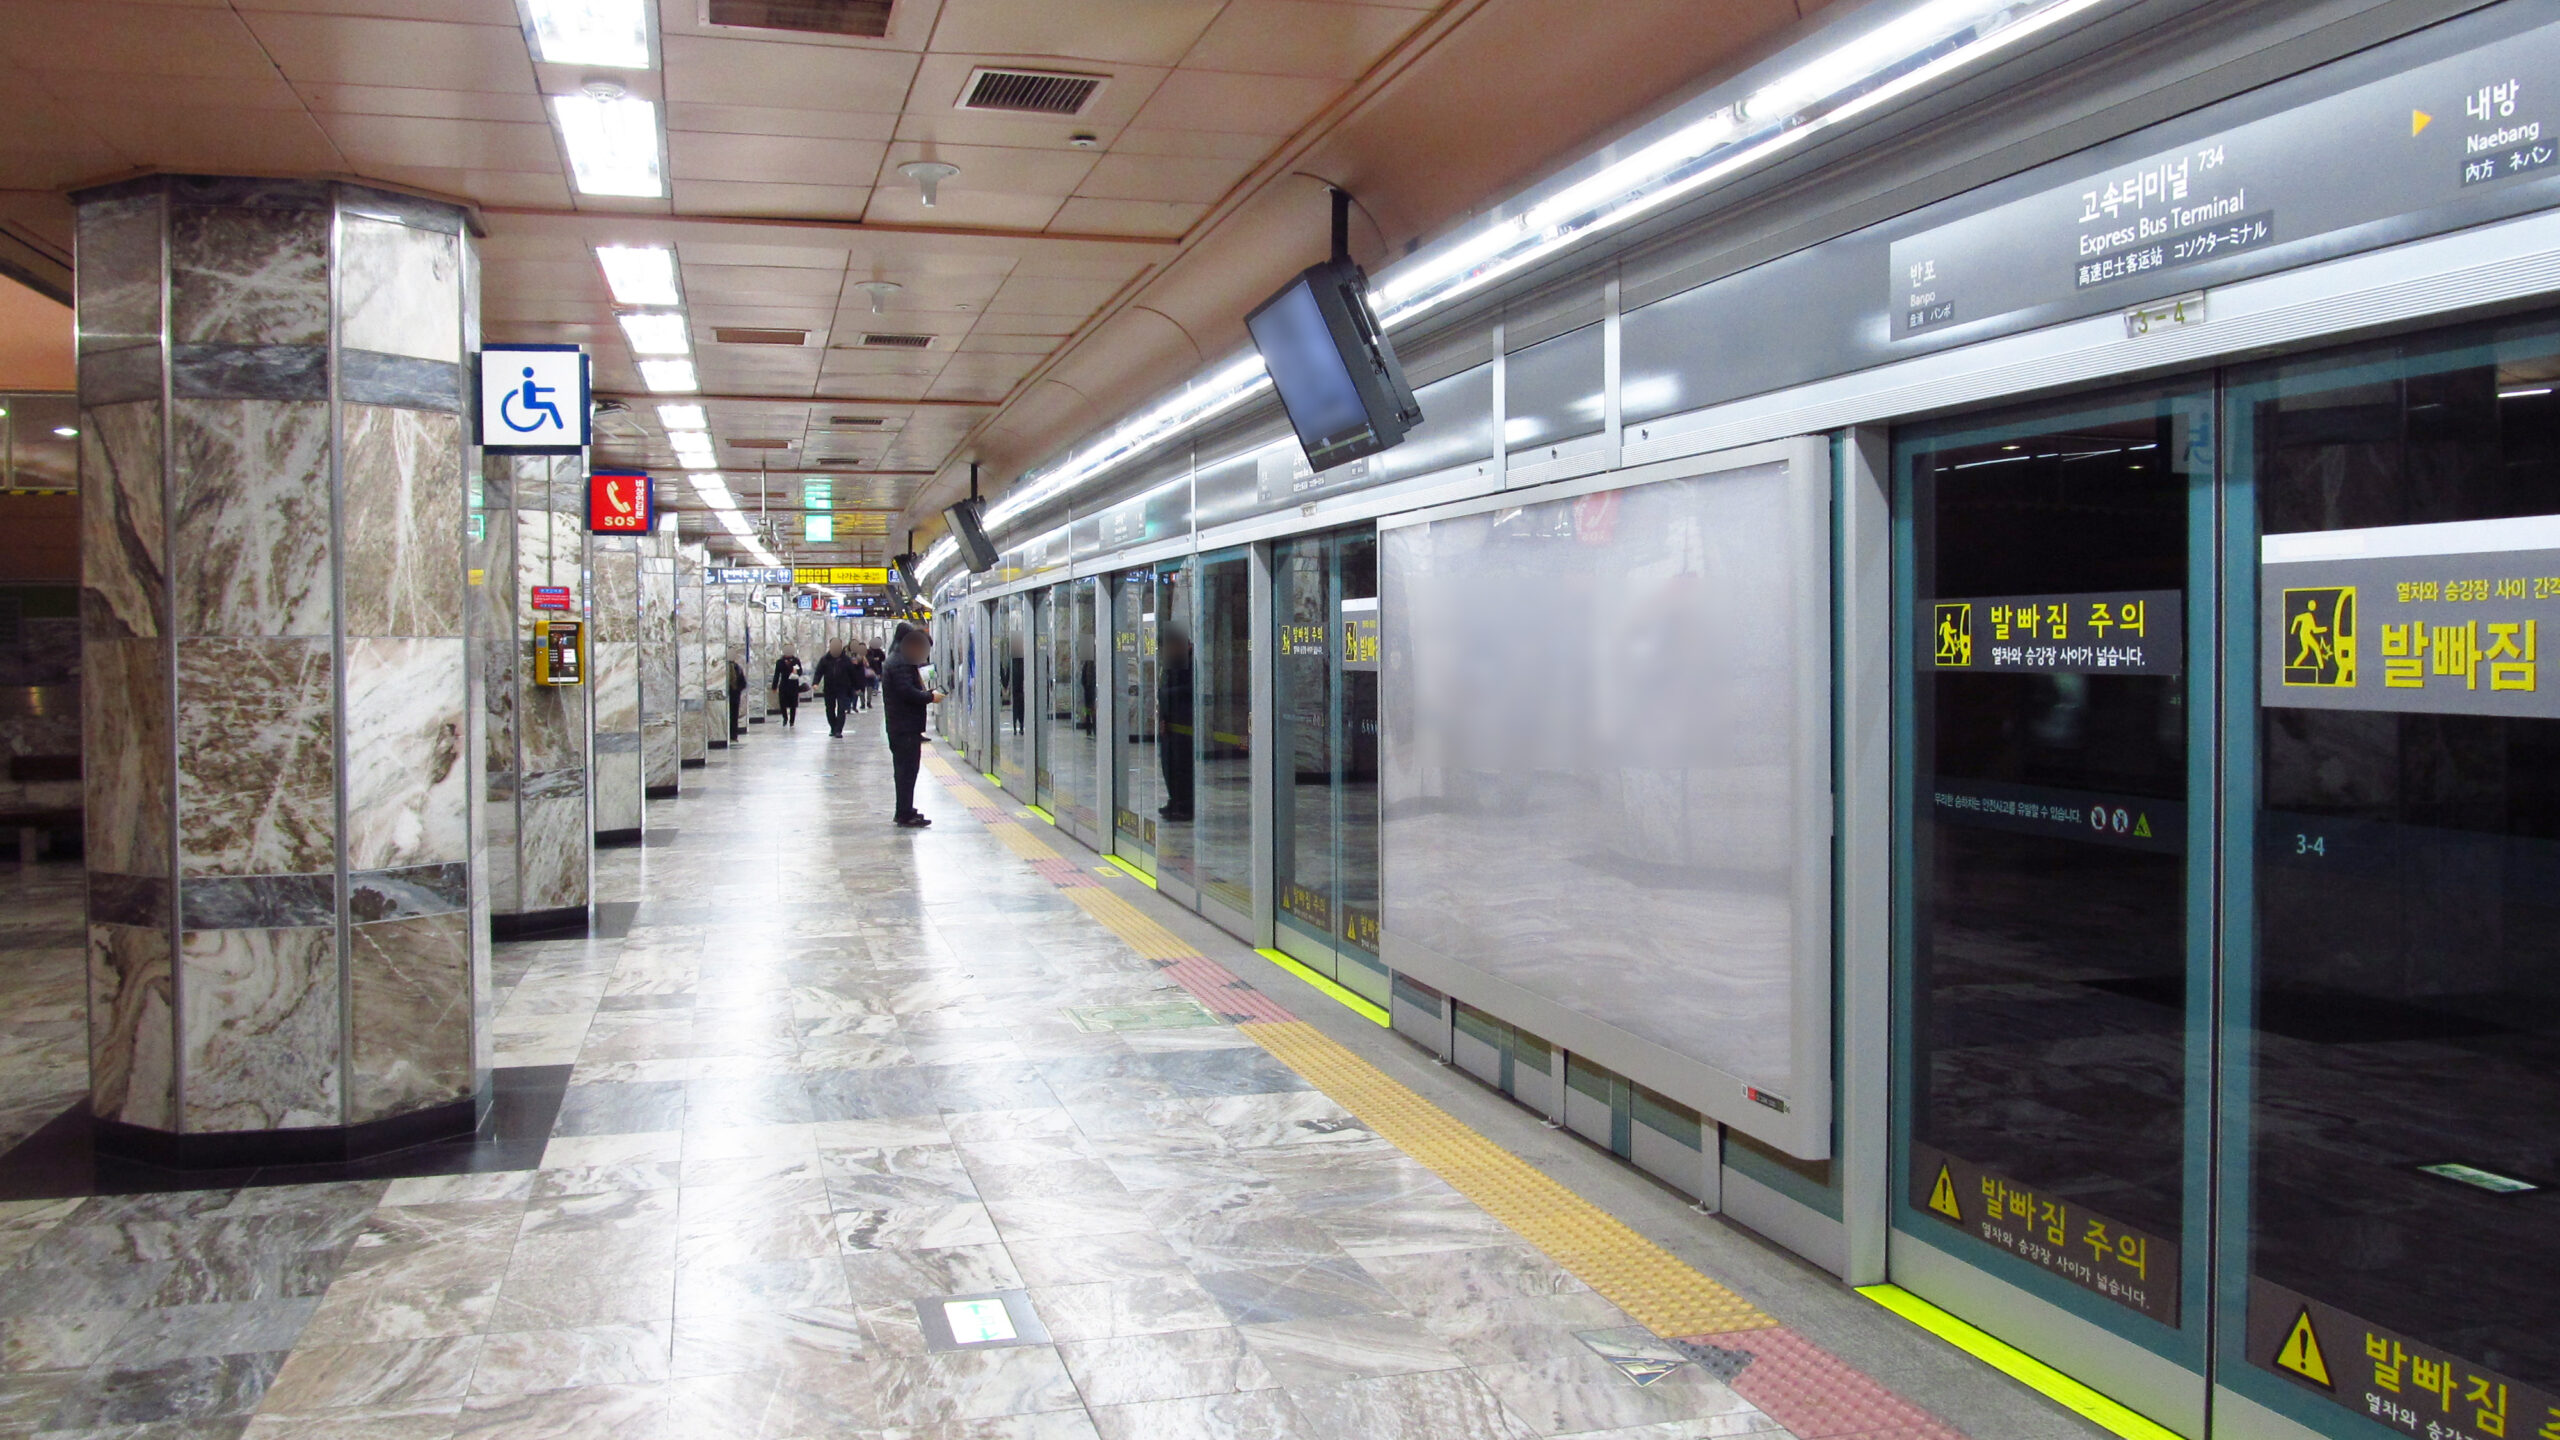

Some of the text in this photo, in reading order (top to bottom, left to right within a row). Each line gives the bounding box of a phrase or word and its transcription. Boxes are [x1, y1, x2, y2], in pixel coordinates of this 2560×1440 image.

[2466, 78, 2520, 120] 내방
[2467, 121, 2540, 154] Naebang
[2509, 146, 2552, 171] ネバン
[2078, 144, 2225, 224] 고속터미널 734
[2079, 188, 2244, 256] Express Bus Terminal
[1909, 259, 1937, 288] 반포
[1910, 291, 1936, 307] Banpo
[604, 516, 636, 527] SOS
[2396, 580, 2439, 603] 열차와
[2444, 579, 2490, 602] 승강장
[2495, 577, 2527, 600] 사이
[1990, 599, 2145, 641] 발빠짐 주의
[1991, 646, 2146, 667] 열차와 승강장 사이가 넓습니다.
[2381, 619, 2537, 692] 발빠짐
[2296, 833, 2326, 857] 3-4
[1981, 1175, 2147, 1281] 발빠짐 주의
[1981, 1221, 2014, 1248] 열차와
[2018, 1238, 2052, 1265] 승강장
[2056, 1255, 2092, 1283] 사이가
[2365, 1331, 2508, 1438] 발빠짐
[2365, 1391, 2418, 1430] 열차와
